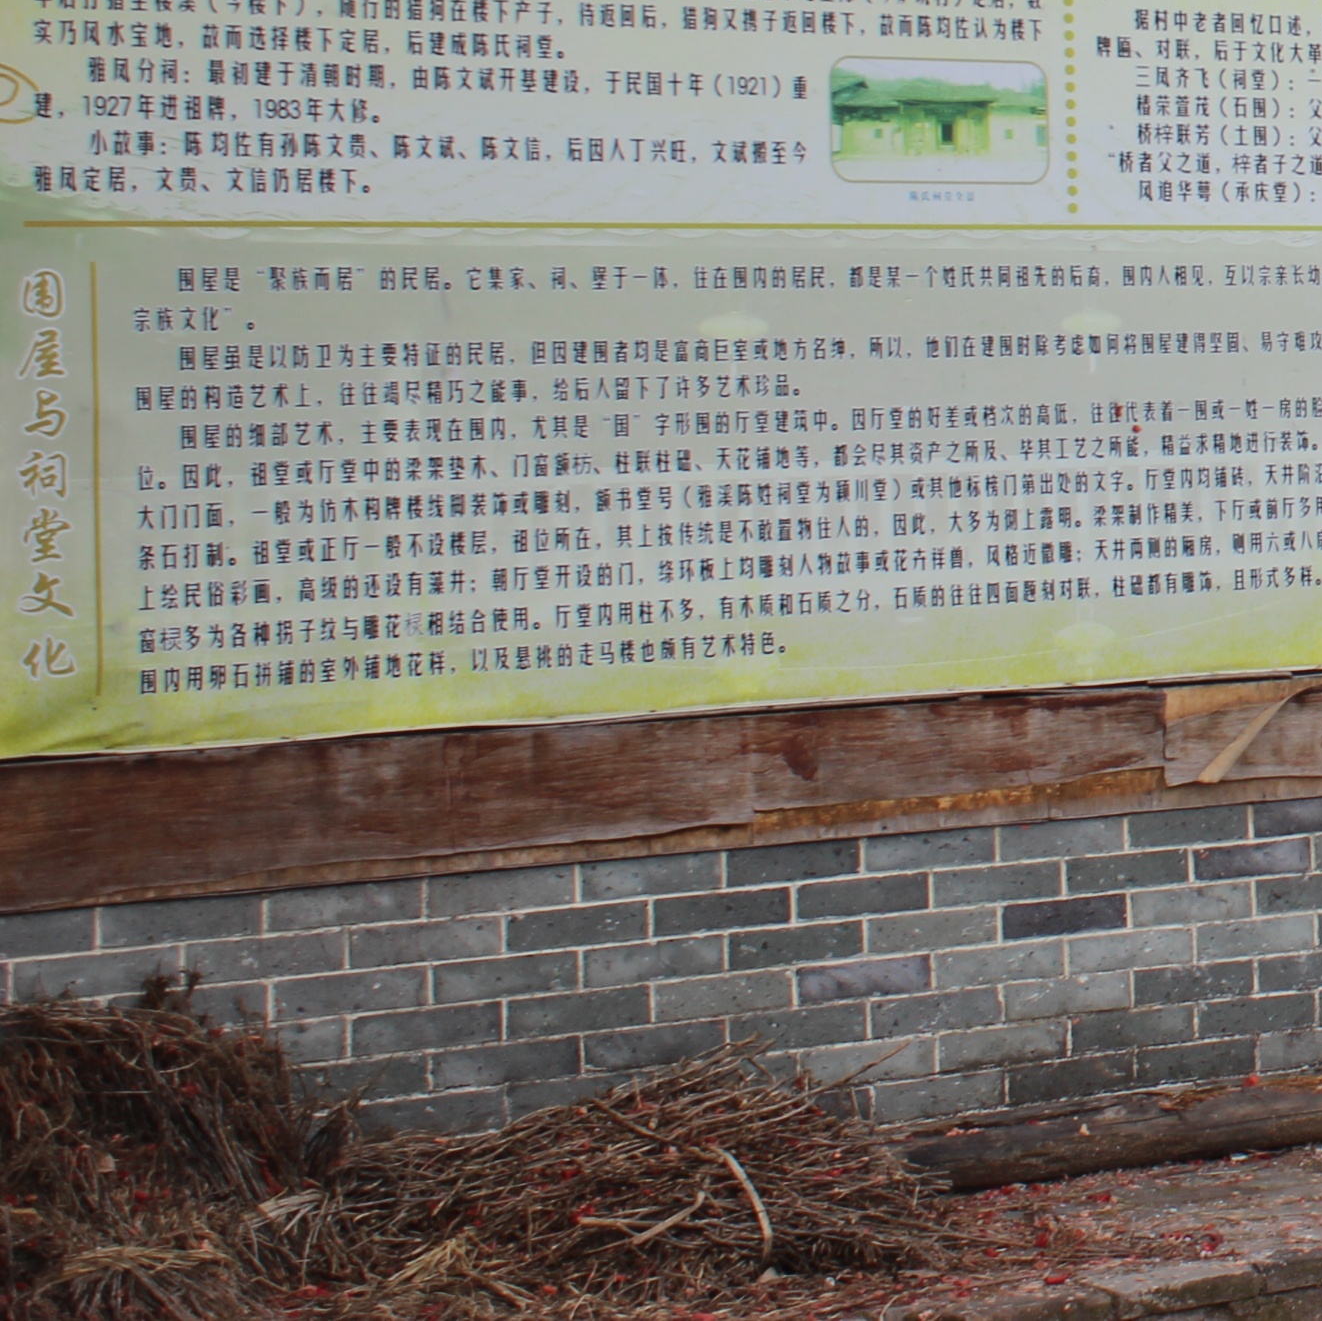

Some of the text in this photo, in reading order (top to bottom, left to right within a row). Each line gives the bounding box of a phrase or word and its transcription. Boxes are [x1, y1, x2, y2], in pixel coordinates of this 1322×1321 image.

[18, 269, 76, 679] 围屋与祠堂文化
